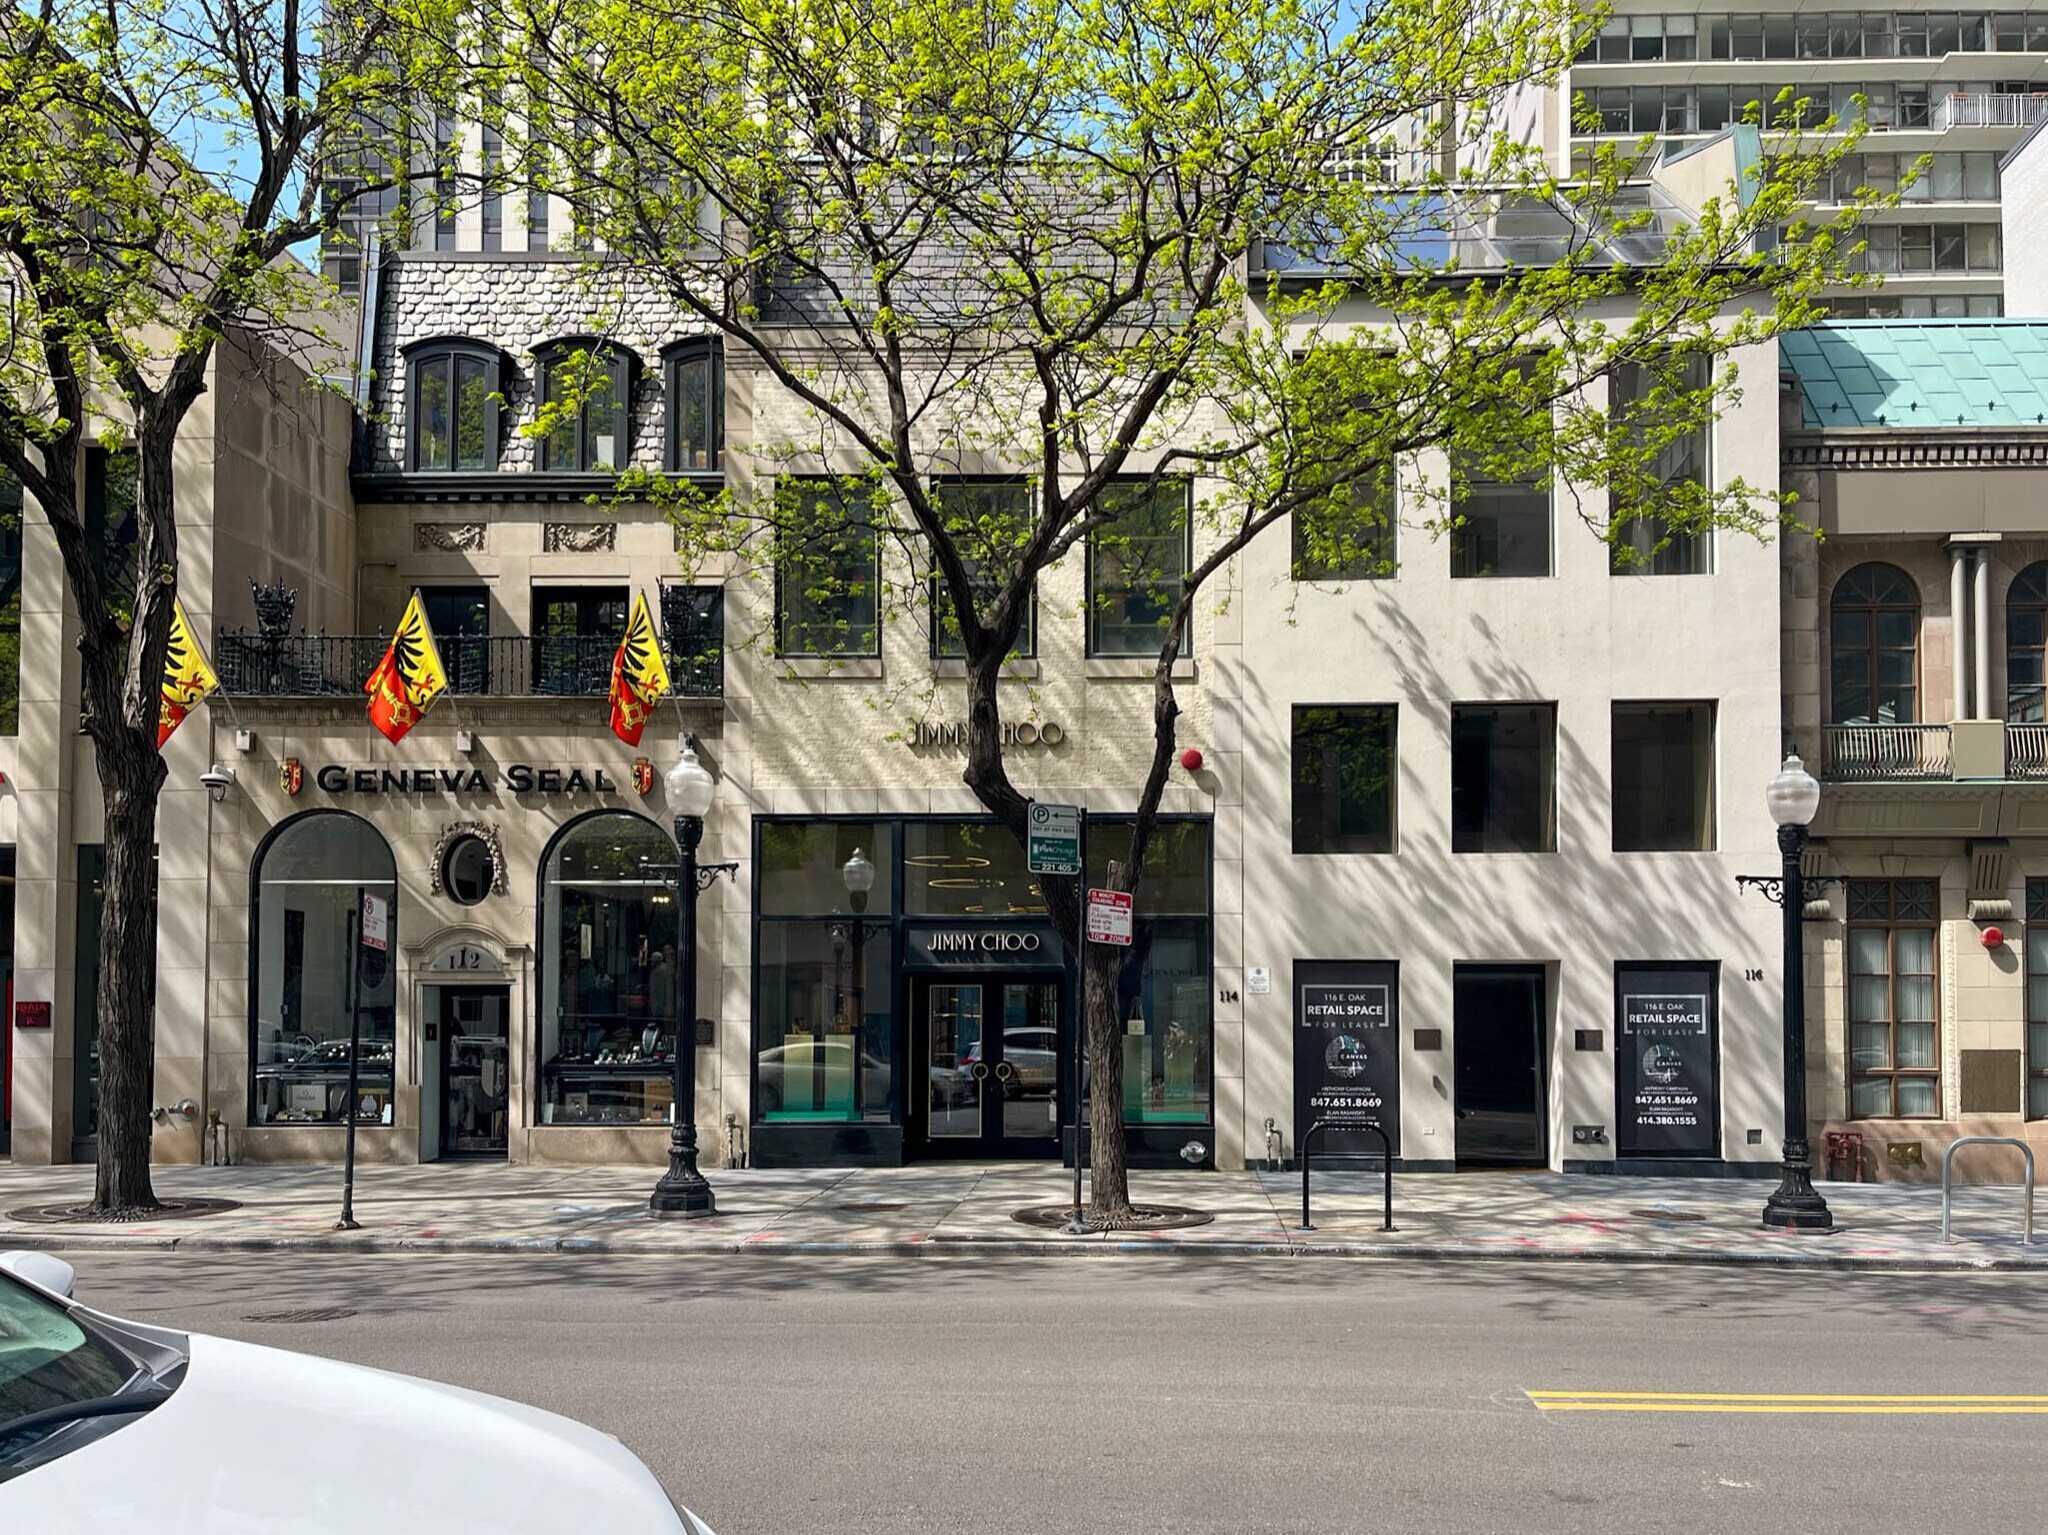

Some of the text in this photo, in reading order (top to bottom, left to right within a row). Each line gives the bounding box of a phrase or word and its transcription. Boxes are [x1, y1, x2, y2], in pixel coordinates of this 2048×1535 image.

[906, 722, 1064, 746] JIMMY HOO
[506, 765, 616, 793] SEAL
[1041, 863, 1056, 871] 221
[927, 933, 1040, 951] JIMMY CHOO
[1091, 932, 1127, 943] TOW ZONE
[449, 946, 481, 970] 112
[1745, 968, 1764, 981] 116
[1219, 990, 1240, 1004] 114
[1324, 993, 1337, 1001] 116
[1347, 993, 1367, 1001] OAK
[1307, 1005, 1383, 1015] RETAIL SPACE
[1629, 1014, 1701, 1023] RETAIL SPACE
[1310, 1097, 1382, 1107] 847.651.8669
[1635, 1095, 1698, 1105] 847.651.8669
[1637, 1116, 1697, 1125] 414.380.1555
